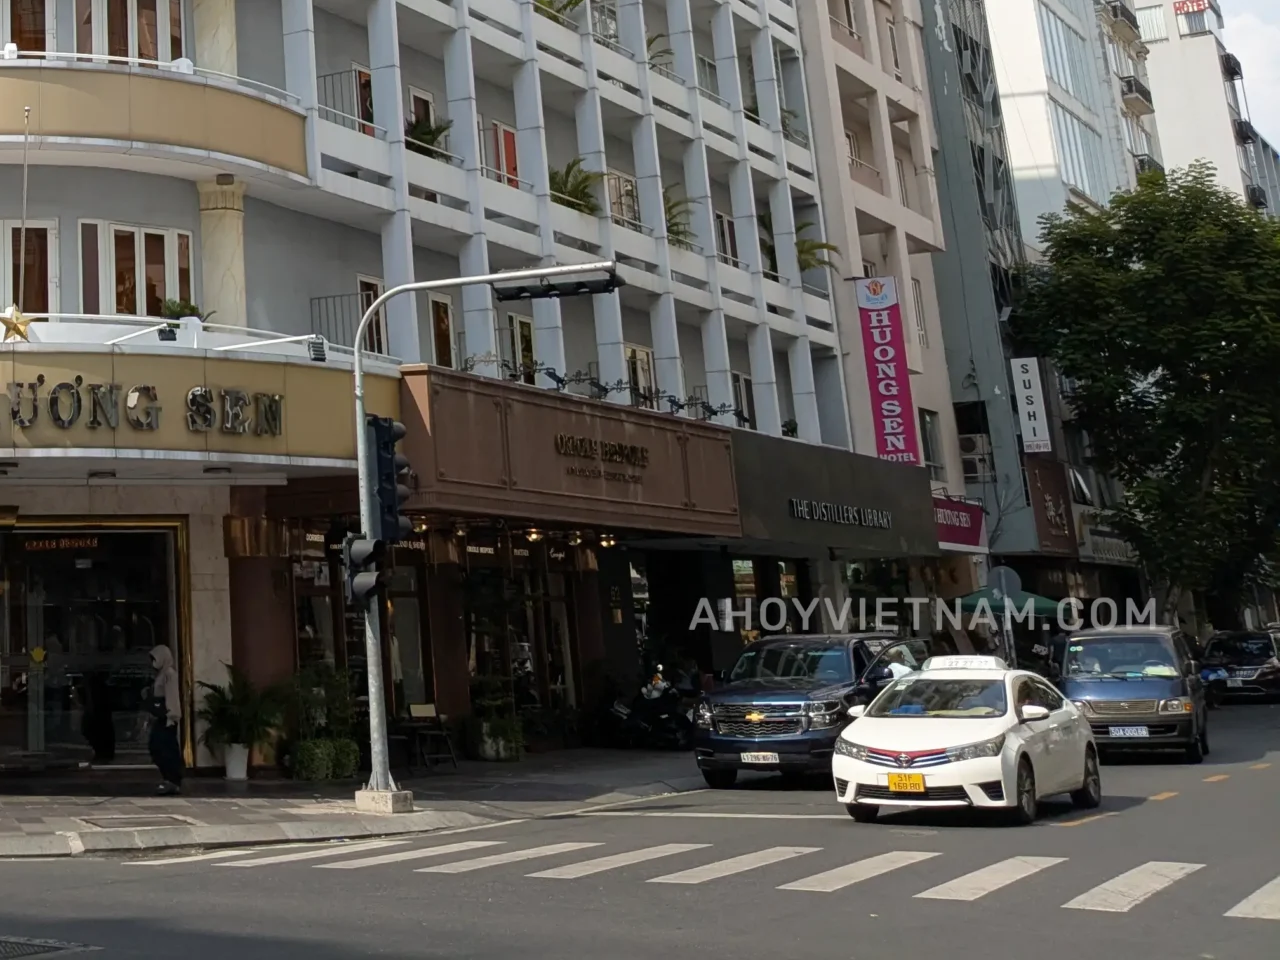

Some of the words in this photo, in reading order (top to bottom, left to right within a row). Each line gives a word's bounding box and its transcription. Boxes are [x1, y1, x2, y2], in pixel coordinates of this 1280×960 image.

[868, 311, 900, 396] HUONG
[186, 385, 284, 437] SEN
[881, 400, 906, 451] SEN
[1020, 363, 1037, 437] SUSHI
[880, 453, 917, 462] HOTEL
[790, 498, 810, 520] THE
[811, 501, 859, 526] DISTILLERS
[859, 507, 892, 530] LIBRARY
